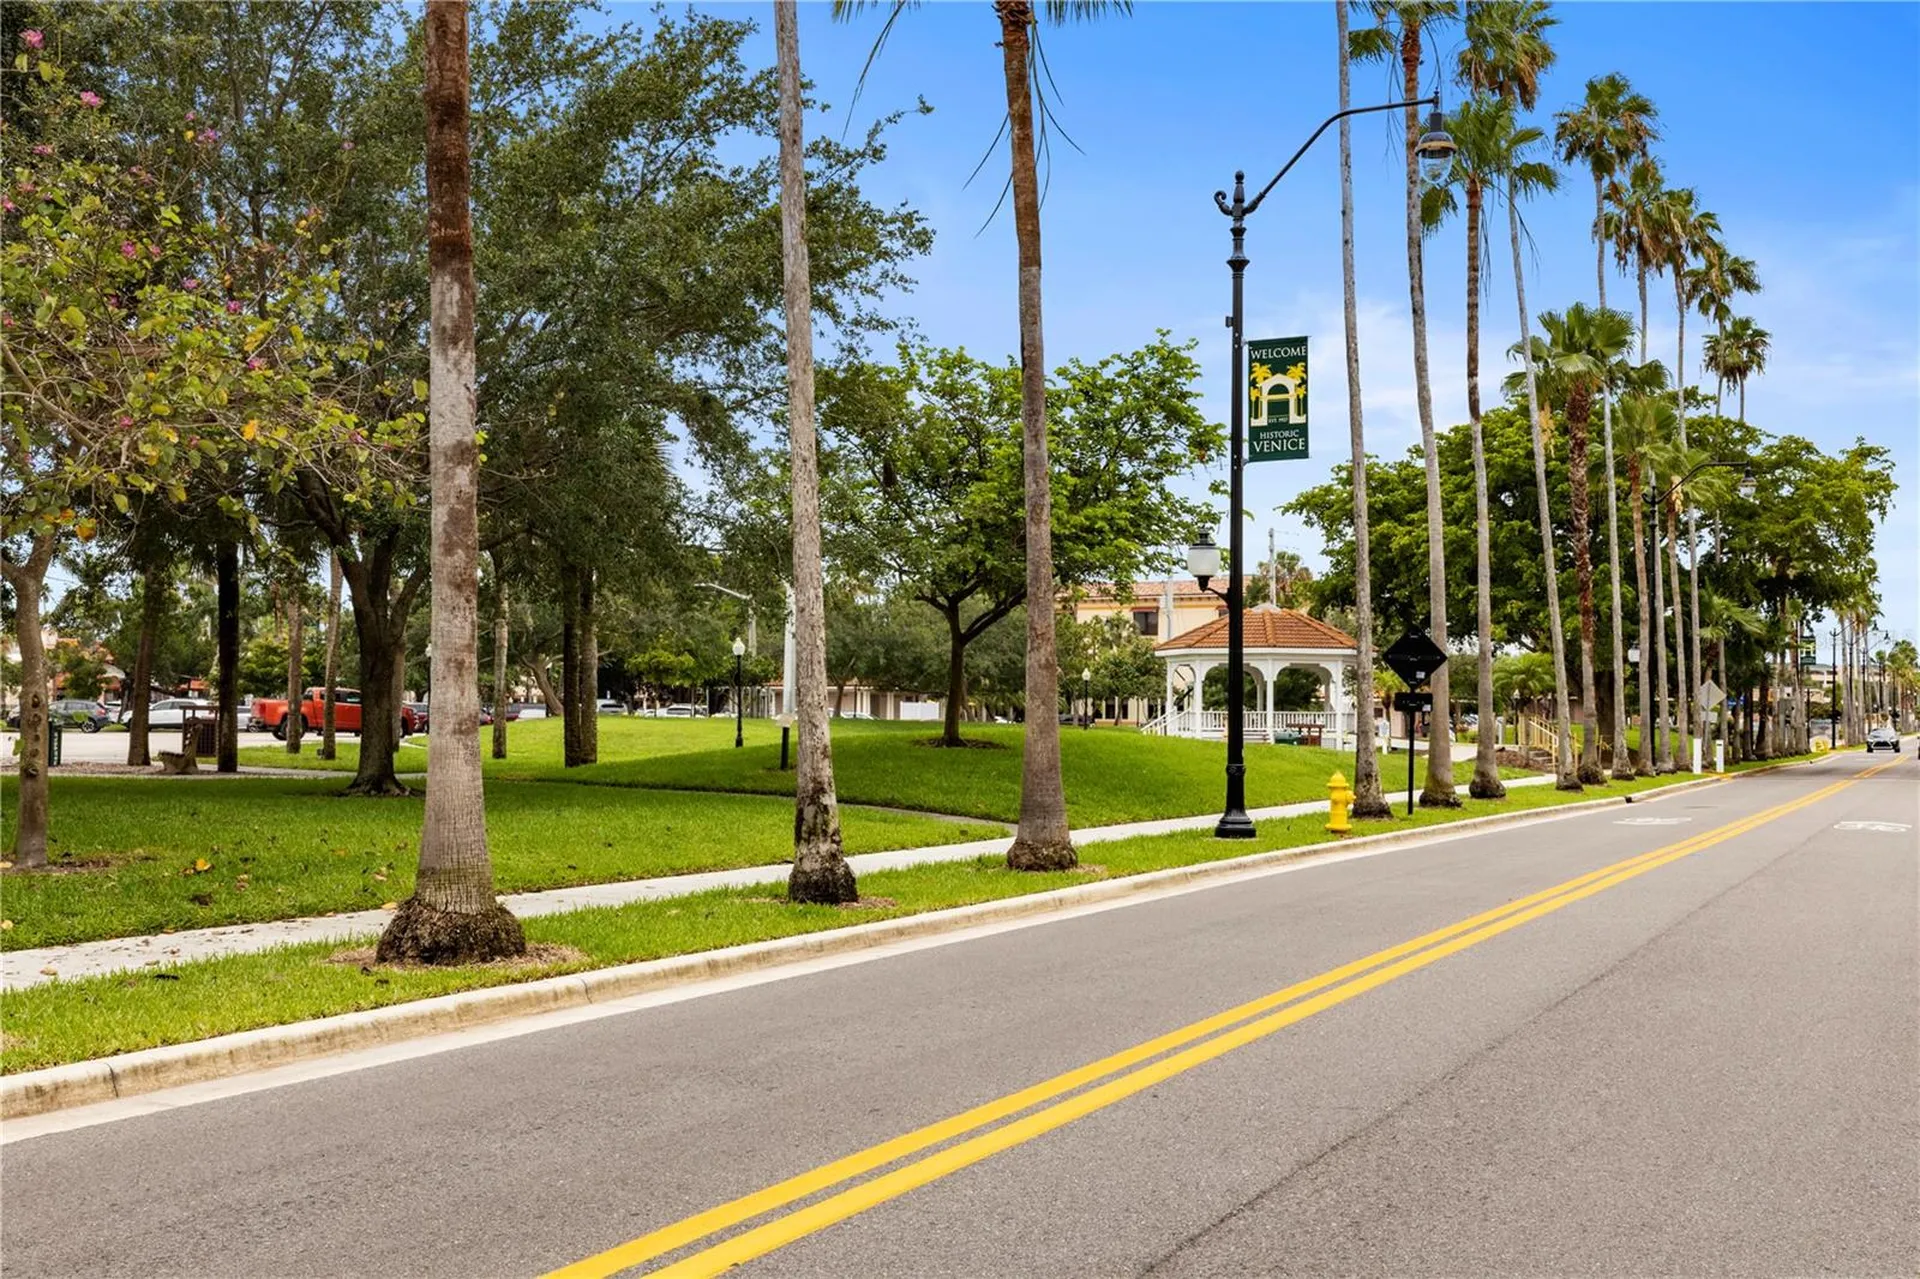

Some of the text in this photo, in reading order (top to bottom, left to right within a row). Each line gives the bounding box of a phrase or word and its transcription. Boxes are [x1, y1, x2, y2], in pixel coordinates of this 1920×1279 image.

[1250, 346, 1306, 360] WELCOME
[1259, 429, 1299, 440] HISTORIC
[1253, 438, 1305, 452] VENICE
